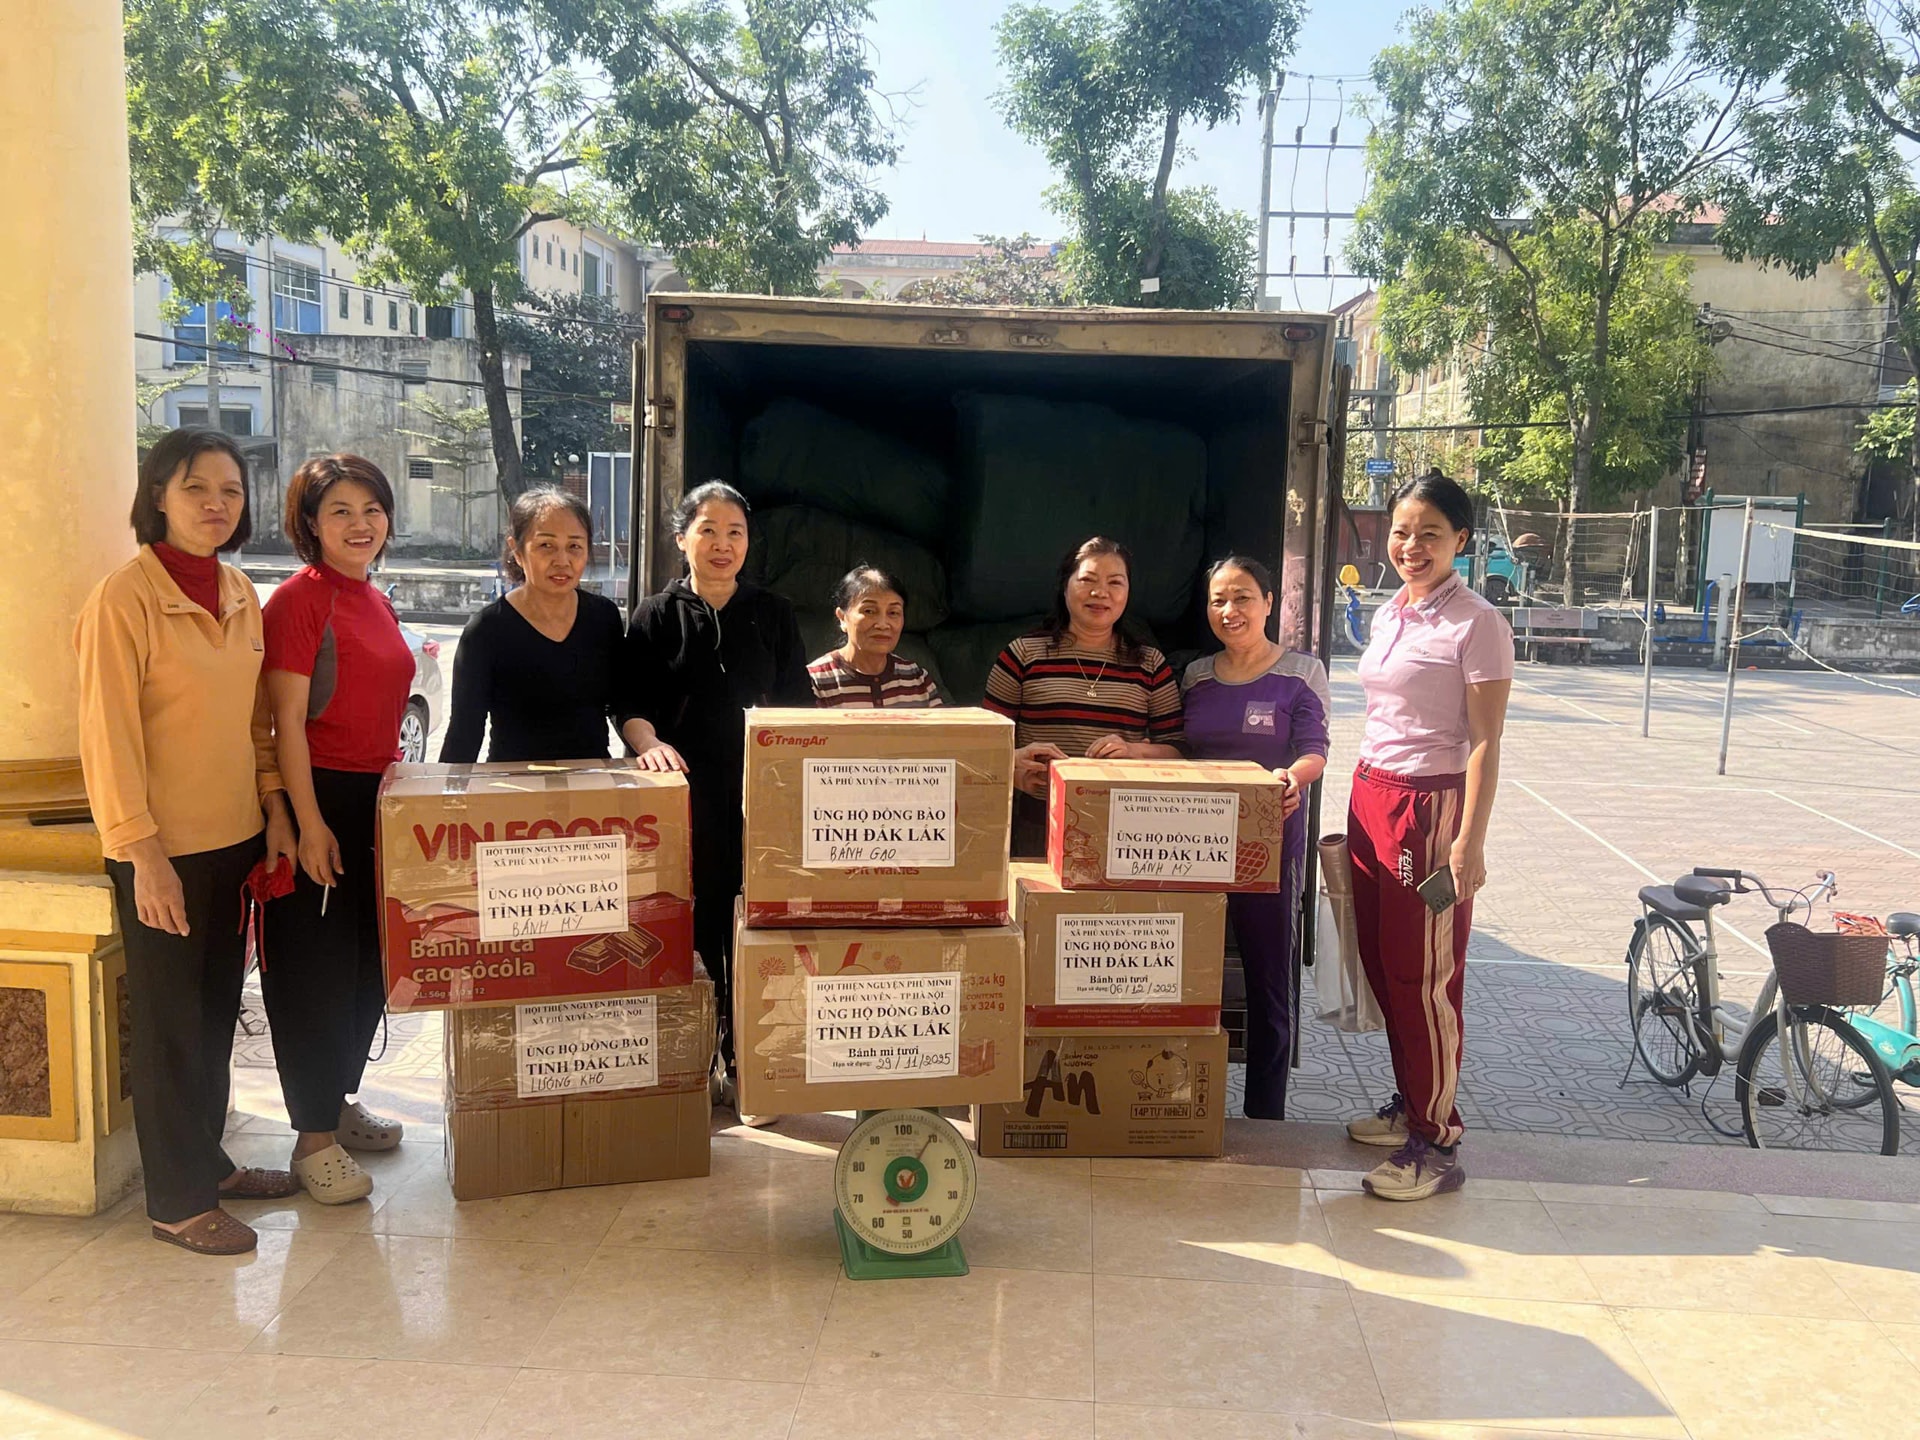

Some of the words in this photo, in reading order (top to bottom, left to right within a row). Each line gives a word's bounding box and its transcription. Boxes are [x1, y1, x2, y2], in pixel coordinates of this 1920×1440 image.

[813, 765, 830, 774] HỘI
[831, 765, 860, 774] THIỆN
[863, 765, 899, 774] NGUYỆN
[902, 763, 920, 773] PHÚ
[923, 765, 947, 773] MINH
[820, 776, 833, 785] XÃ
[835, 776, 854, 785] PHÚ
[856, 776, 887, 785] XUYÊN
[896, 777, 907, 785] TP
[908, 776, 921, 785] HÀ
[923, 776, 939, 786] NỘI
[1118, 795, 1132, 803] HỘI
[1135, 795, 1158, 803] THIỆN
[1160, 796, 1191, 804] NGUYỆN
[1193, 796, 1208, 804] PHÚ
[814, 807, 843, 820] ỦNG
[848, 808, 868, 823] HỘ
[873, 807, 912, 820] ĐỒNG
[917, 806, 946, 820] BÀO
[812, 824, 857, 841] TỈNH
[863, 824, 903, 841] ĐẮK
[908, 824, 946, 841] LẮK
[1117, 830, 1142, 842] ỦNG
[1146, 832, 1163, 844] HỘ
[1166, 832, 1200, 844] ĐỒNG
[1204, 833, 1229, 845] BÀO
[486, 847, 504, 857] HỘI
[505, 846, 532, 856] THIỆN
[535, 843, 571, 854] NGUYỆN
[573, 841, 591, 851] PHÚ
[593, 841, 618, 850] MINH
[830, 842, 863, 862] BÁNH
[1115, 845, 1153, 860] TỈNH
[1158, 846, 1191, 861] ĐẮK
[1196, 847, 1228, 862] LẮK
[1132, 860, 1163, 875] BÁNH
[488, 887, 517, 900] ỦNG
[522, 885, 542, 899] HỘ
[547, 883, 586, 896] ĐỒNG
[590, 880, 618, 893] BÀO
[488, 903, 533, 919] TỈNH
[539, 899, 577, 915] ĐẮK
[583, 896, 618, 912] LẮK
[512, 918, 549, 937] BÁNH
[1080, 919, 1103, 927] THIỆN
[1105, 919, 1136, 927] NGUYỆN
[1065, 940, 1090, 951] ỦNG
[1093, 940, 1110, 952] HỘ
[1114, 939, 1147, 951] ĐỒNG
[1150, 938, 1175, 950] BÀO
[1063, 953, 1101, 968] TỈNH
[1106, 953, 1138, 968] ĐẮK
[1143, 952, 1175, 967] LẮK
[412, 967, 454, 983] cao
[461, 957, 535, 980] sôcôla
[817, 983, 834, 992] HỘI
[836, 981, 864, 992] THIỆN
[867, 980, 904, 990] NGUYỆN
[907, 978, 924, 989] PHÚ
[927, 979, 952, 987] MINH
[993, 973, 1005, 986] kg
[475, 987, 485, 995] 12
[817, 1006, 848, 1020] ỦNG
[852, 1006, 873, 1021] HỘ
[877, 1004, 918, 1018] ĐỒNG
[922, 1002, 951, 1016] BÀO
[978, 1001, 996, 1010] 324
[816, 1023, 862, 1040] TỈNH
[868, 1021, 908, 1039] ĐẮK
[913, 1019, 951, 1037] LẮK
[894, 1125, 912, 1136] 100
[870, 1136, 880, 1145] 90
[853, 1161, 865, 1172] 80
[944, 1158, 956, 1170] 20
[853, 1194, 864, 1203] 70
[948, 1190, 958, 1200] 30
[872, 1217, 884, 1229] 60
[929, 1215, 941, 1226] 40
[902, 1229, 913, 1239] 50
